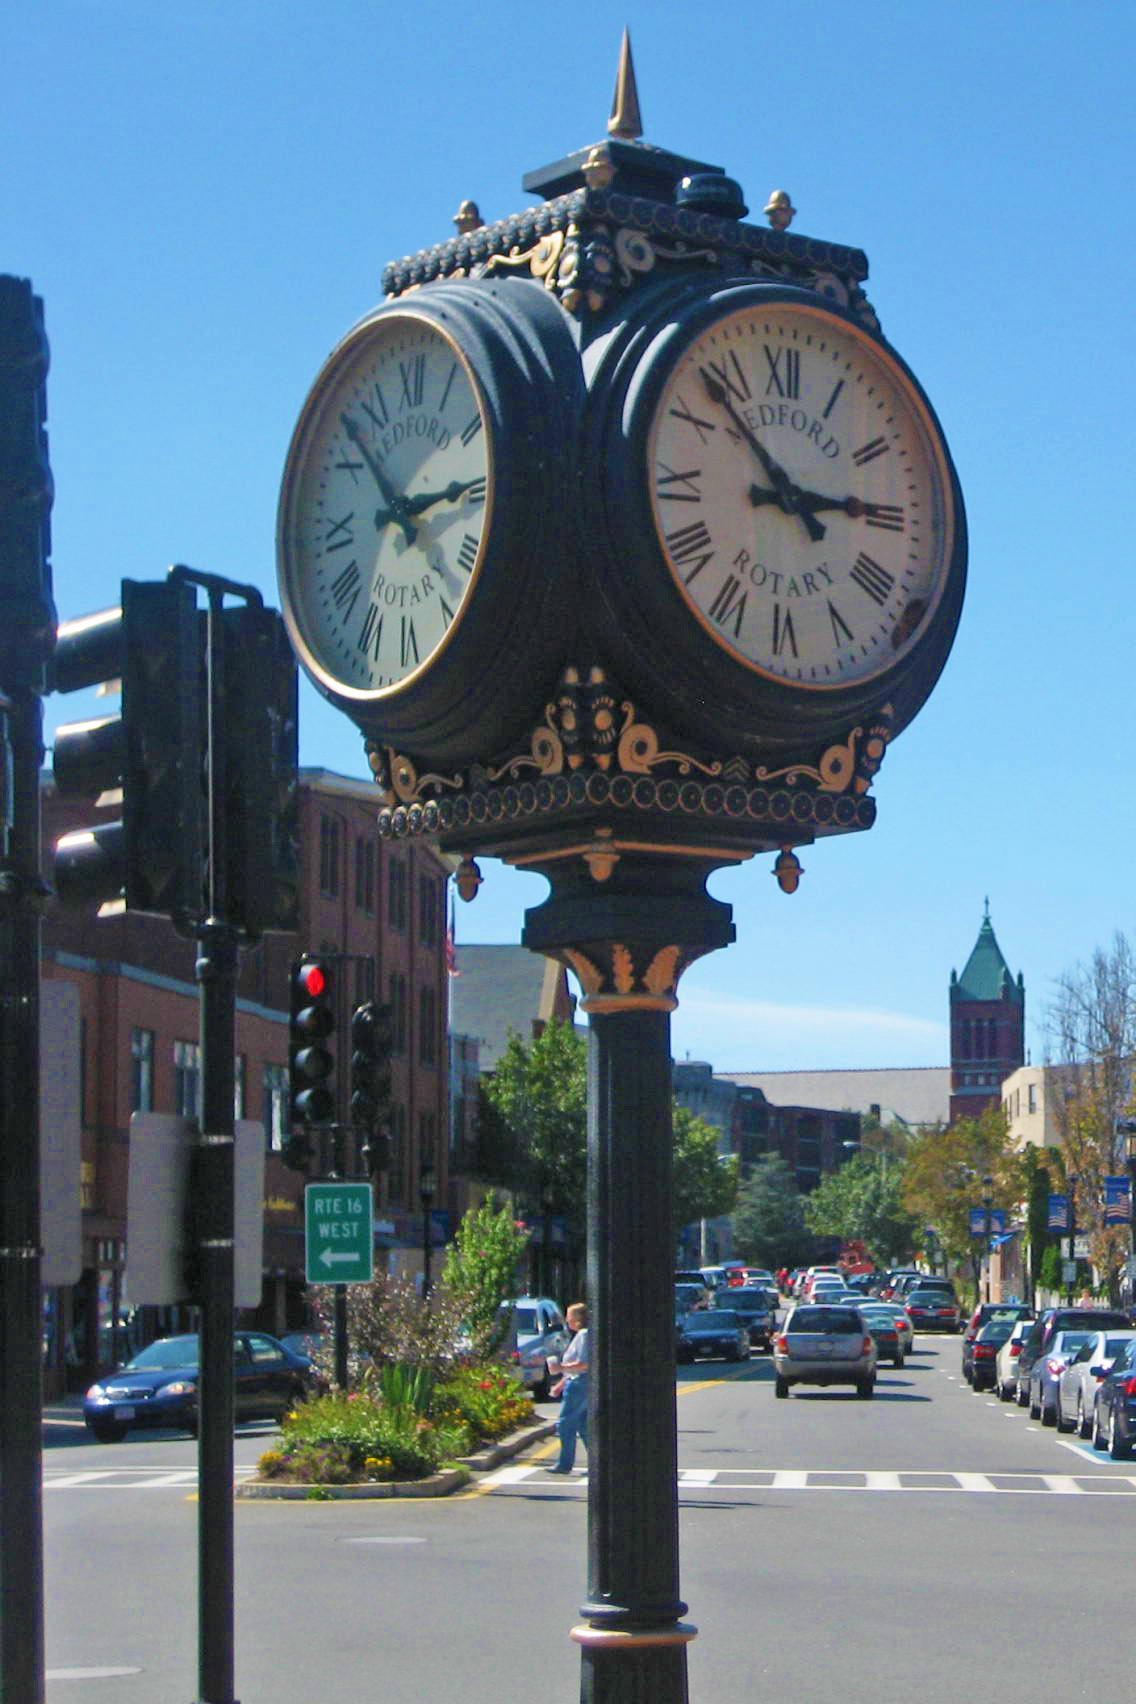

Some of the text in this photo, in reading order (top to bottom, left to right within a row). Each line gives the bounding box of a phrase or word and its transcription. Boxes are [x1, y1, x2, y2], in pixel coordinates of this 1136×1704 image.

[399, 354, 425, 408] XII
[440, 361, 457, 413] I
[763, 343, 800, 401] XII
[669, 394, 716, 446] X
[822, 377, 846, 420] I
[461, 413, 484, 448] II
[852, 435, 890, 468] II
[335, 446, 363, 486] X
[657, 461, 701, 503] IX
[326, 511, 354, 553] IX
[665, 520, 715, 586] VIII
[331, 559, 361, 626] VIII
[373, 557, 445, 609] ROTARY
[733, 547, 834, 598] ROTARY
[849, 551, 896, 608] IIII
[357, 602, 384, 663] VII
[708, 574, 748, 639] VII
[772, 603, 798, 659] VI
[826, 598, 855, 649] V
[401, 615, 419, 668] VI
[314, 1198, 342, 1215] RTE
[347, 1198, 363, 1214] 16
[318, 1222, 360, 1238] WEST
